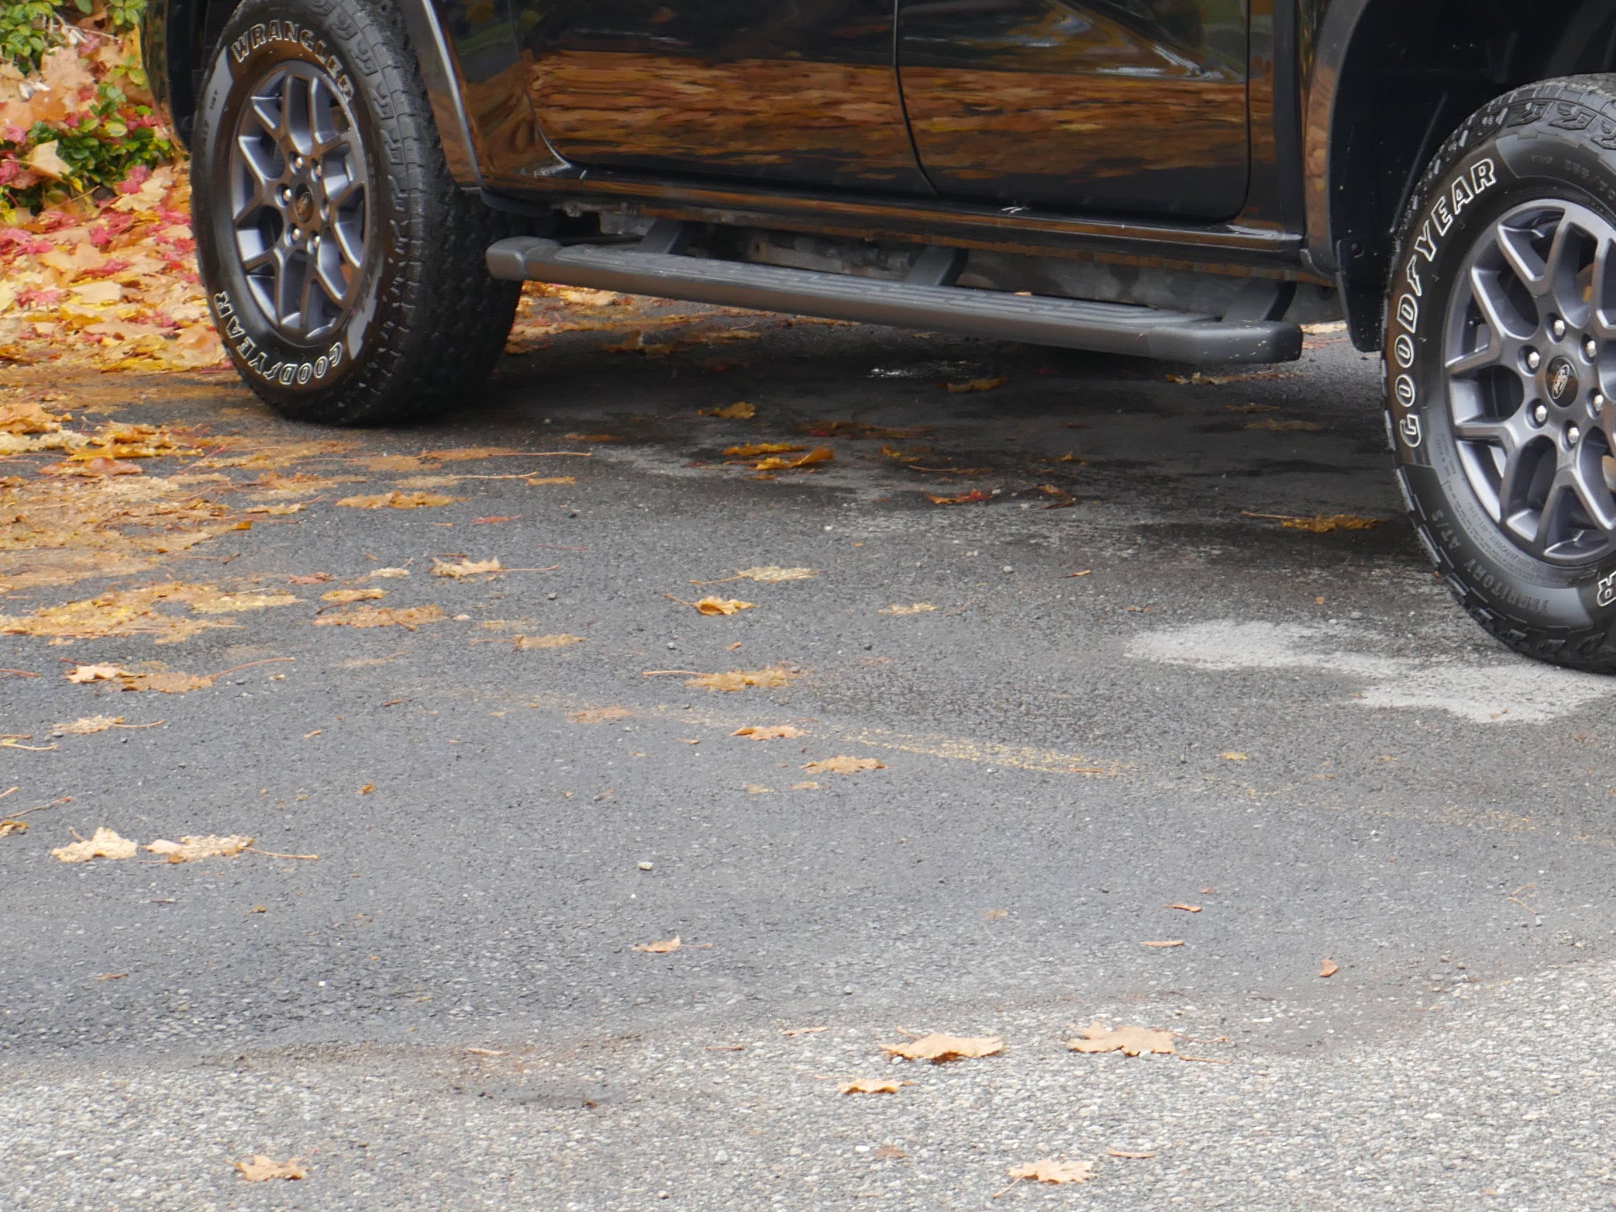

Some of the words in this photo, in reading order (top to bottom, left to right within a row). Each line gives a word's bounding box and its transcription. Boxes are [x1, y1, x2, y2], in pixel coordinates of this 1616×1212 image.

[230, 19, 355, 104] WRANGLER
[212, 290, 344, 387] GOODYEAR
[1395, 157, 1497, 449] GOODYEAR
